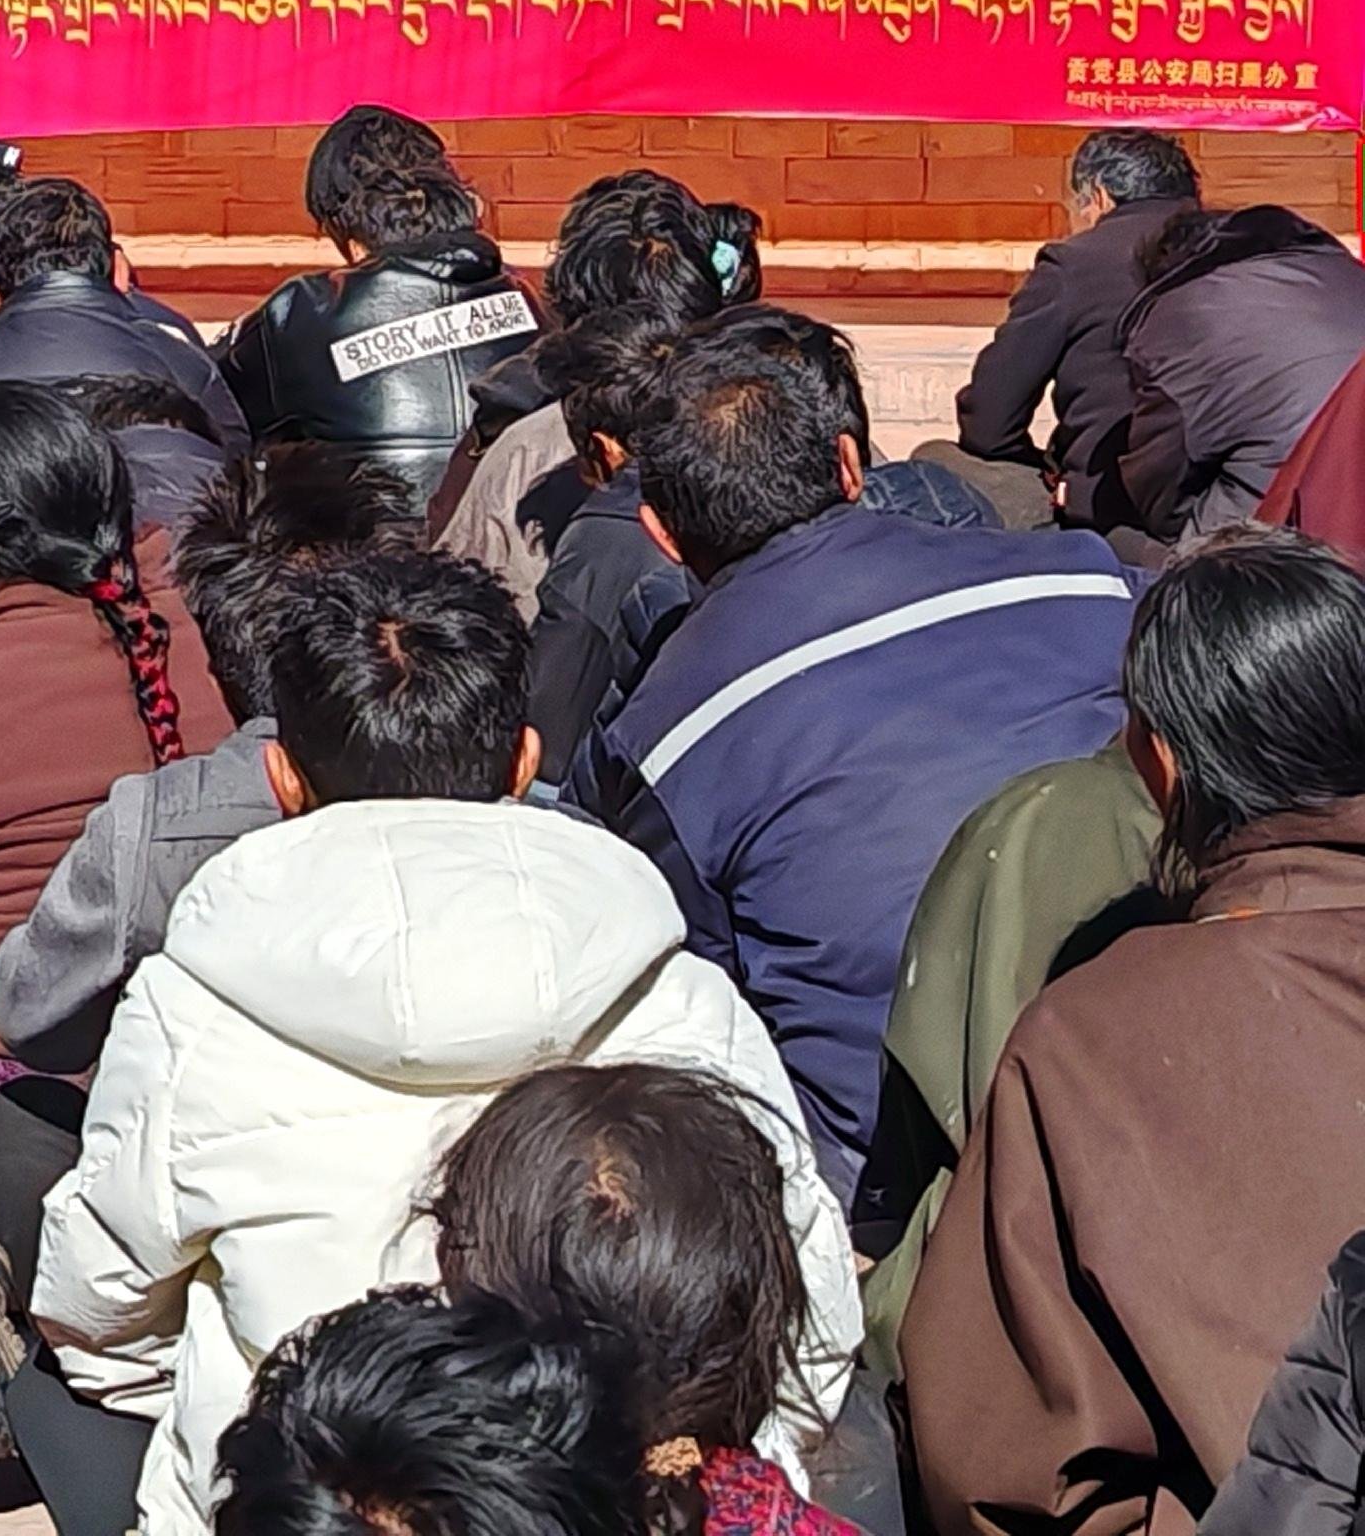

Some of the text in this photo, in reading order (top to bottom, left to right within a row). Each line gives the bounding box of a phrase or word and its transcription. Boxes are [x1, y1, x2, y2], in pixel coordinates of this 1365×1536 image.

[345, 320, 418, 361] STORY
[381, 342, 416, 363] YOU
[415, 329, 461, 351] WANT
